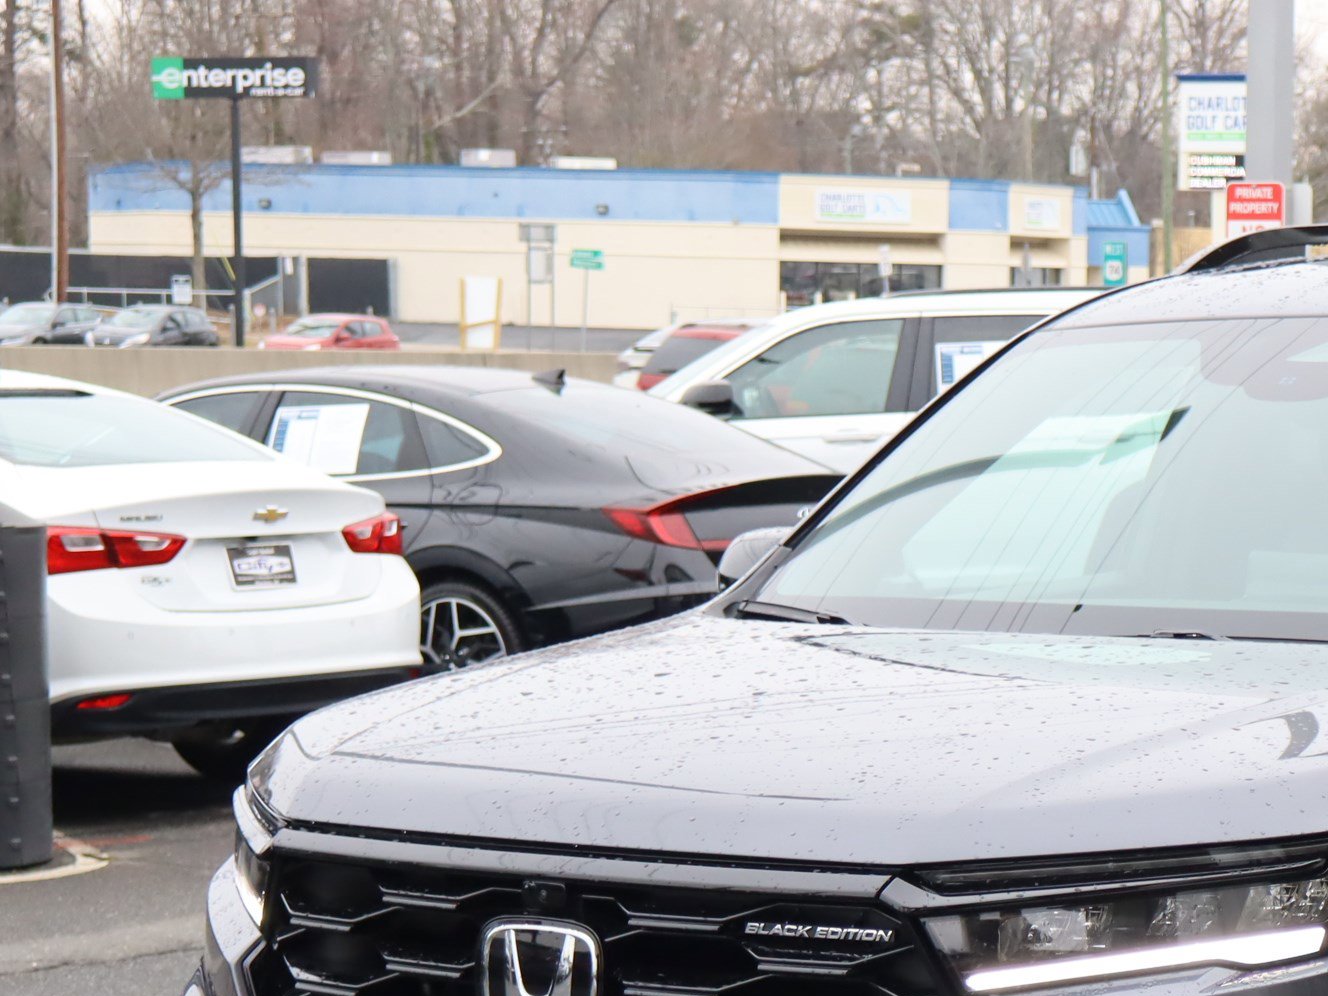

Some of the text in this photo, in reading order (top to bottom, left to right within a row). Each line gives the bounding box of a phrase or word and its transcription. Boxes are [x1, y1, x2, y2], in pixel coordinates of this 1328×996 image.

[154, 61, 306, 93] enterprise
[1235, 187, 1274, 199] PRIVATE
[1229, 202, 1280, 214] PROPERTY
[745, 922, 893, 942] BLACK EDITION
